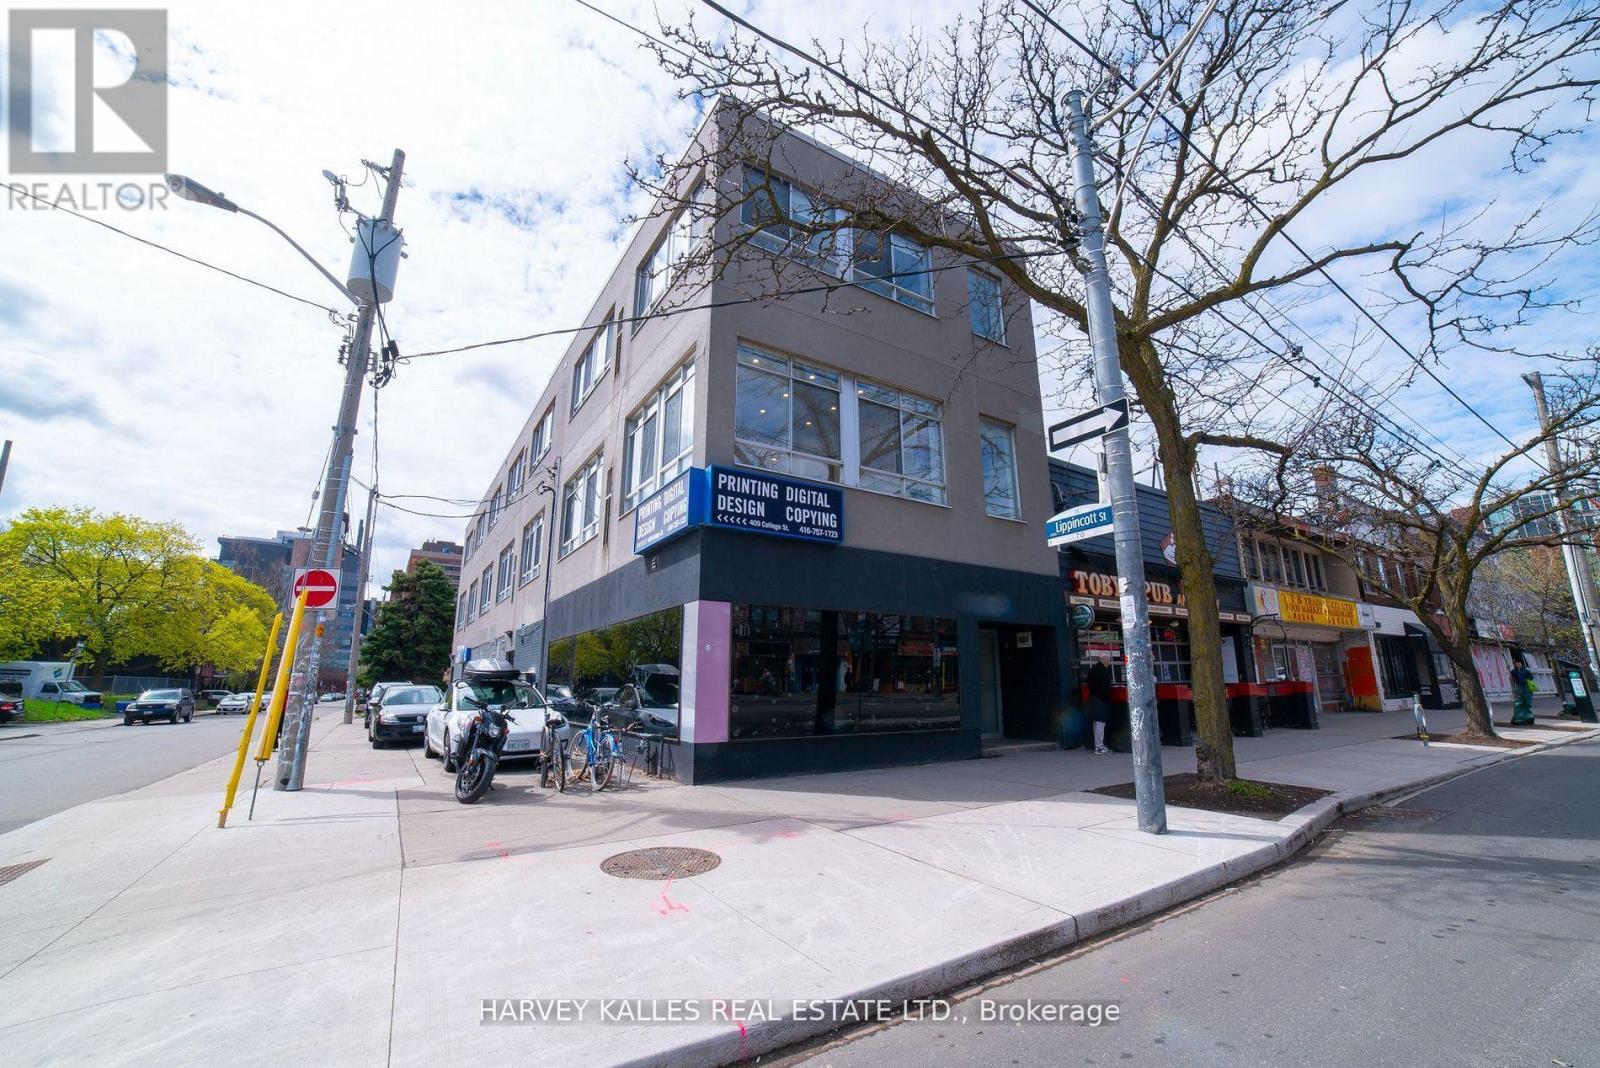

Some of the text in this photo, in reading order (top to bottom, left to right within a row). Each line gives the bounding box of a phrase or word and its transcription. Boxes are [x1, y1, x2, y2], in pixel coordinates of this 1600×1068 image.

[718, 473, 831, 508] PRINTING DIGITAL
[717, 494, 838, 528] DESIGN COPYING
[1055, 511, 1107, 534] Lippincott St
[761, 521, 782, 531] College
